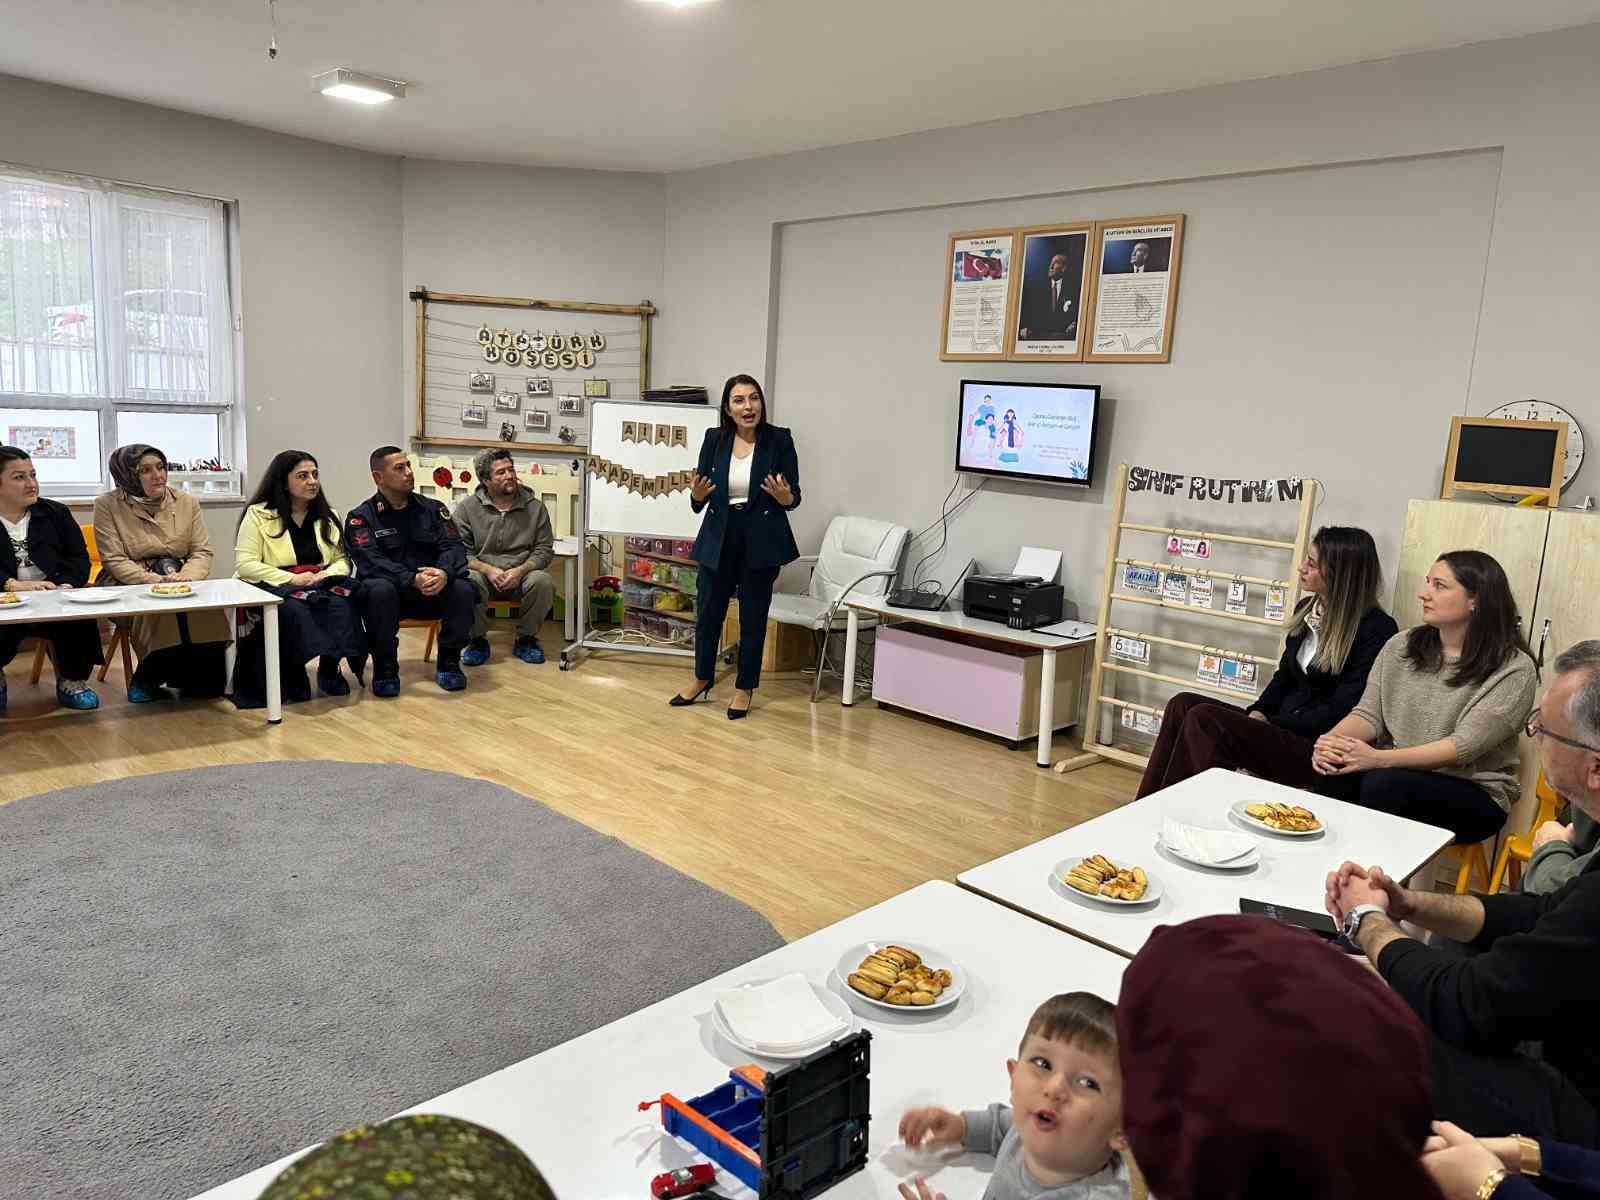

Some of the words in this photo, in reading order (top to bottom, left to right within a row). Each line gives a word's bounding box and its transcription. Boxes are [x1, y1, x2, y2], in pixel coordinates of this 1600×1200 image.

[1527, 410, 1538, 420] 12
[623, 422, 683, 441] AİLE
[1231, 582, 1240, 597] 5
[1115, 638, 1123, 651] 6
